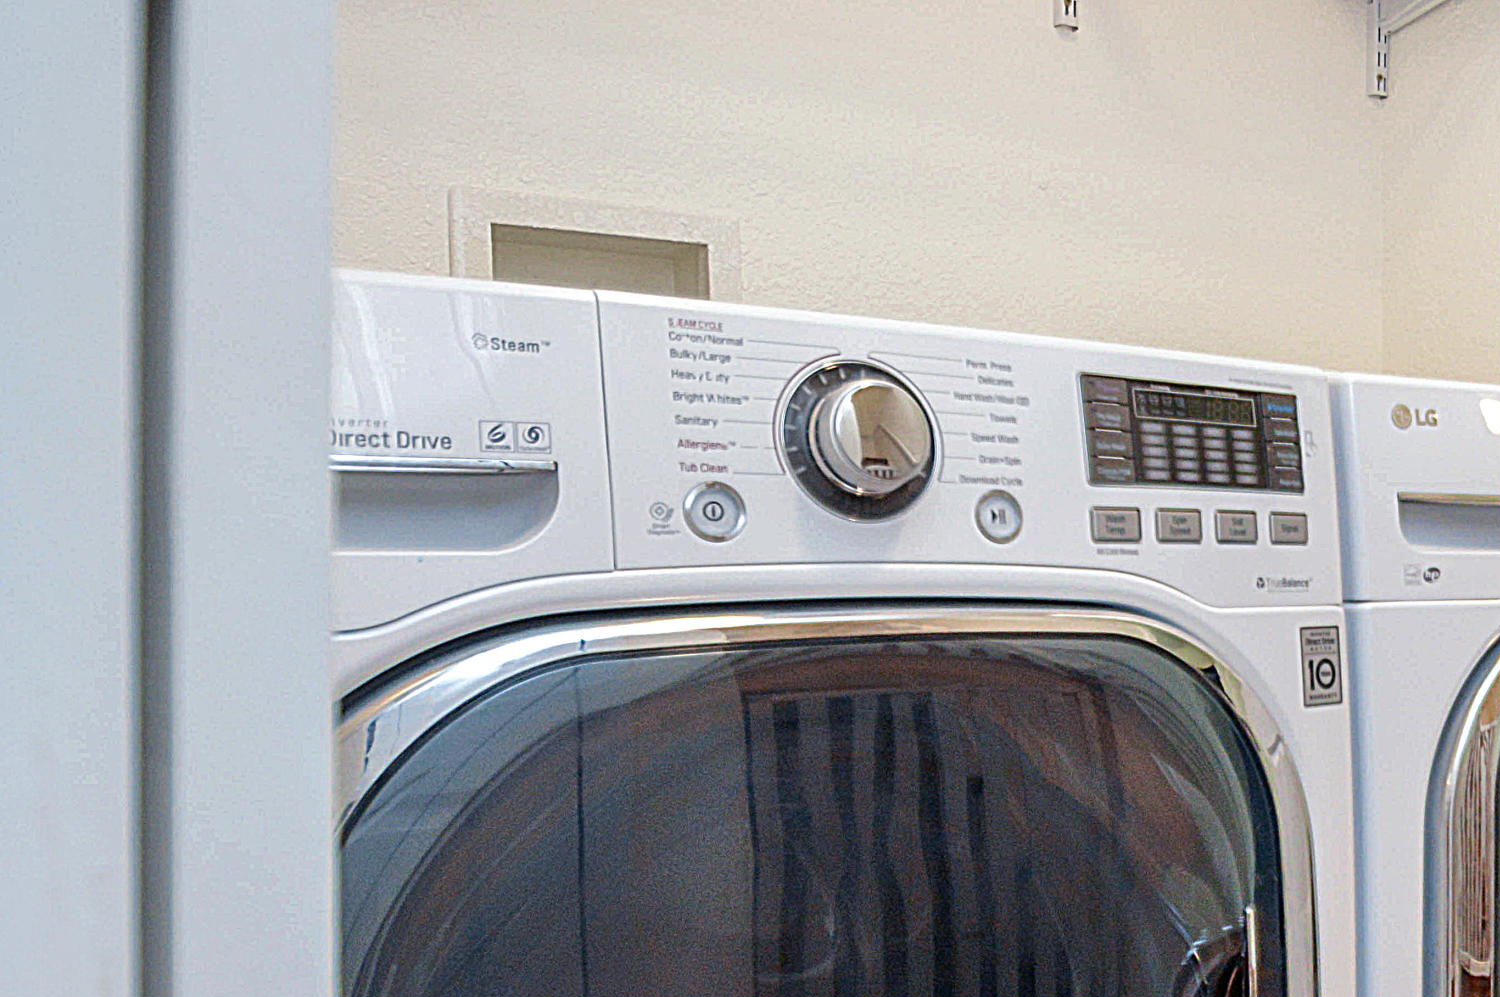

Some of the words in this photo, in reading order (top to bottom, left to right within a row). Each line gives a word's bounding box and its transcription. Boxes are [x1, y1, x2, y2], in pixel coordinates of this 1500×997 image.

[669, 348, 731, 364] Bulky/Large
[672, 391, 704, 404] Bright
[674, 414, 718, 428] Sanitary
[1415, 408, 1437, 426] LG
[396, 430, 452, 449] Drive
[679, 461, 698, 472] Tub
[699, 462, 728, 473] Clean
[1308, 658, 1336, 691] 10
